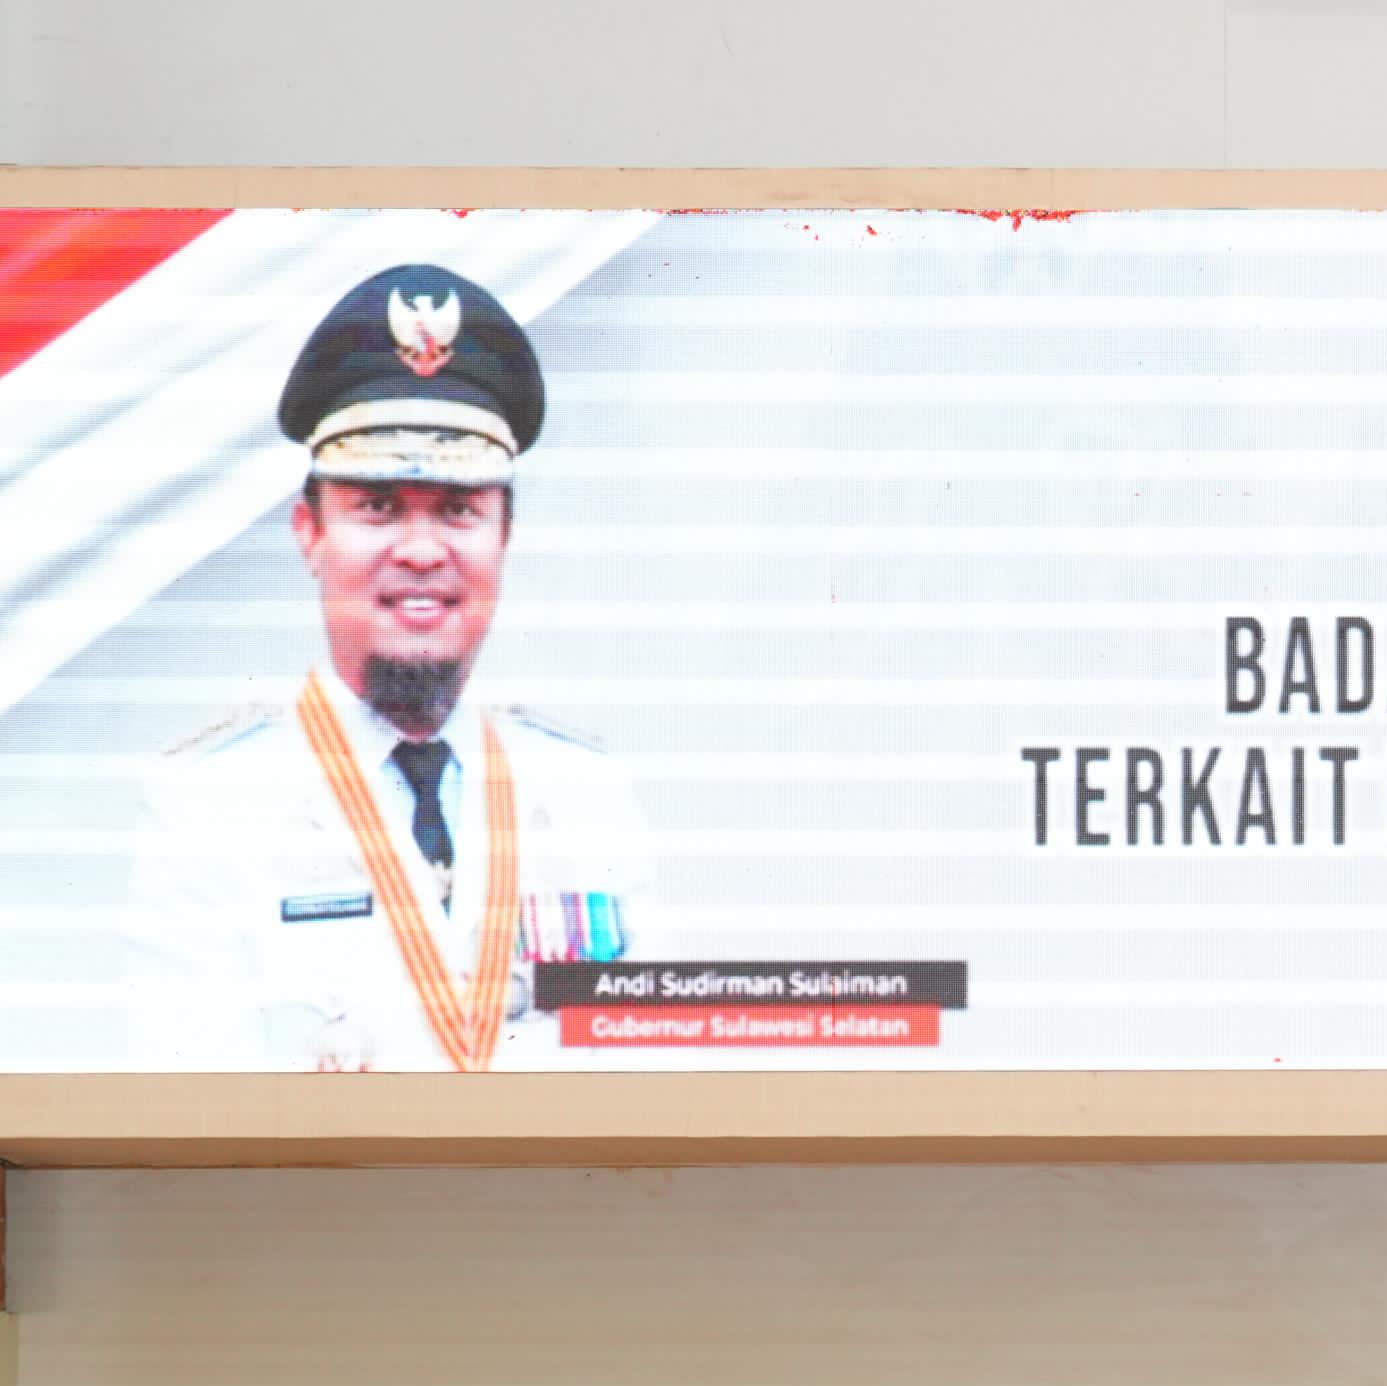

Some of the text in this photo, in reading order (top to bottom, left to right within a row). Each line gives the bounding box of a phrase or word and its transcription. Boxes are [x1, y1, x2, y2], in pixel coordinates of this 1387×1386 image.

[1021, 746, 1359, 847] TERKAIT
[595, 971, 907, 997] Andi Sudirman Sulaiman
[591, 1013, 909, 1038] Gubernur Sulawesi Selatan
